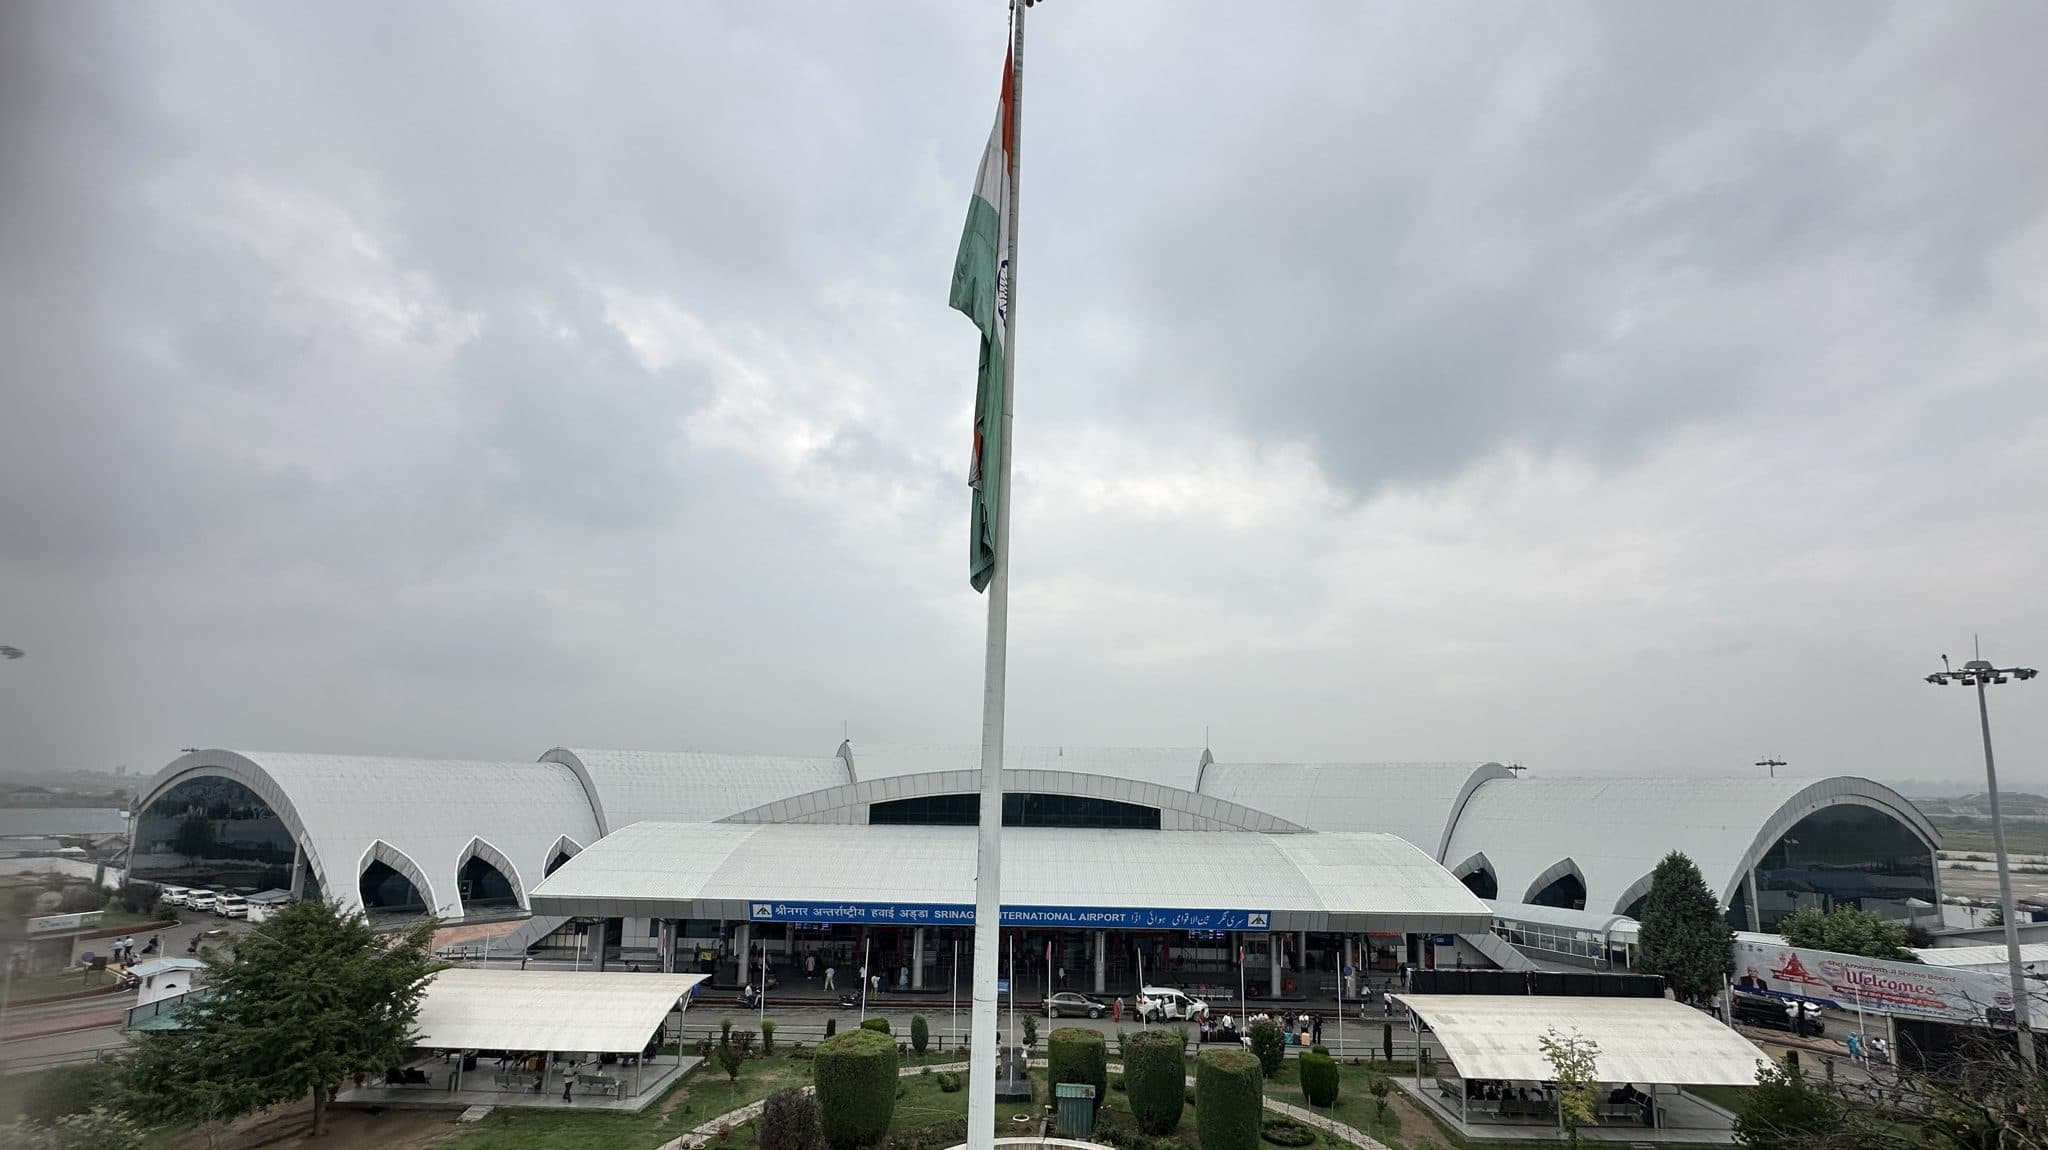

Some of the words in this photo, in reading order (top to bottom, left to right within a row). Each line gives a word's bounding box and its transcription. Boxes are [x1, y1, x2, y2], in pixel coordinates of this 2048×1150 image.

[775, 904, 808, 916] श्रीनगर
[871, 906, 894, 919] हवाई
[934, 910, 976, 920] SRINAG
[999, 911, 1076, 921] TERNATIONAL
[1078, 912, 1126, 922] AIRPORT
[1844, 968, 1936, 995] Welcomes
[1927, 973, 1957, 983] Board
